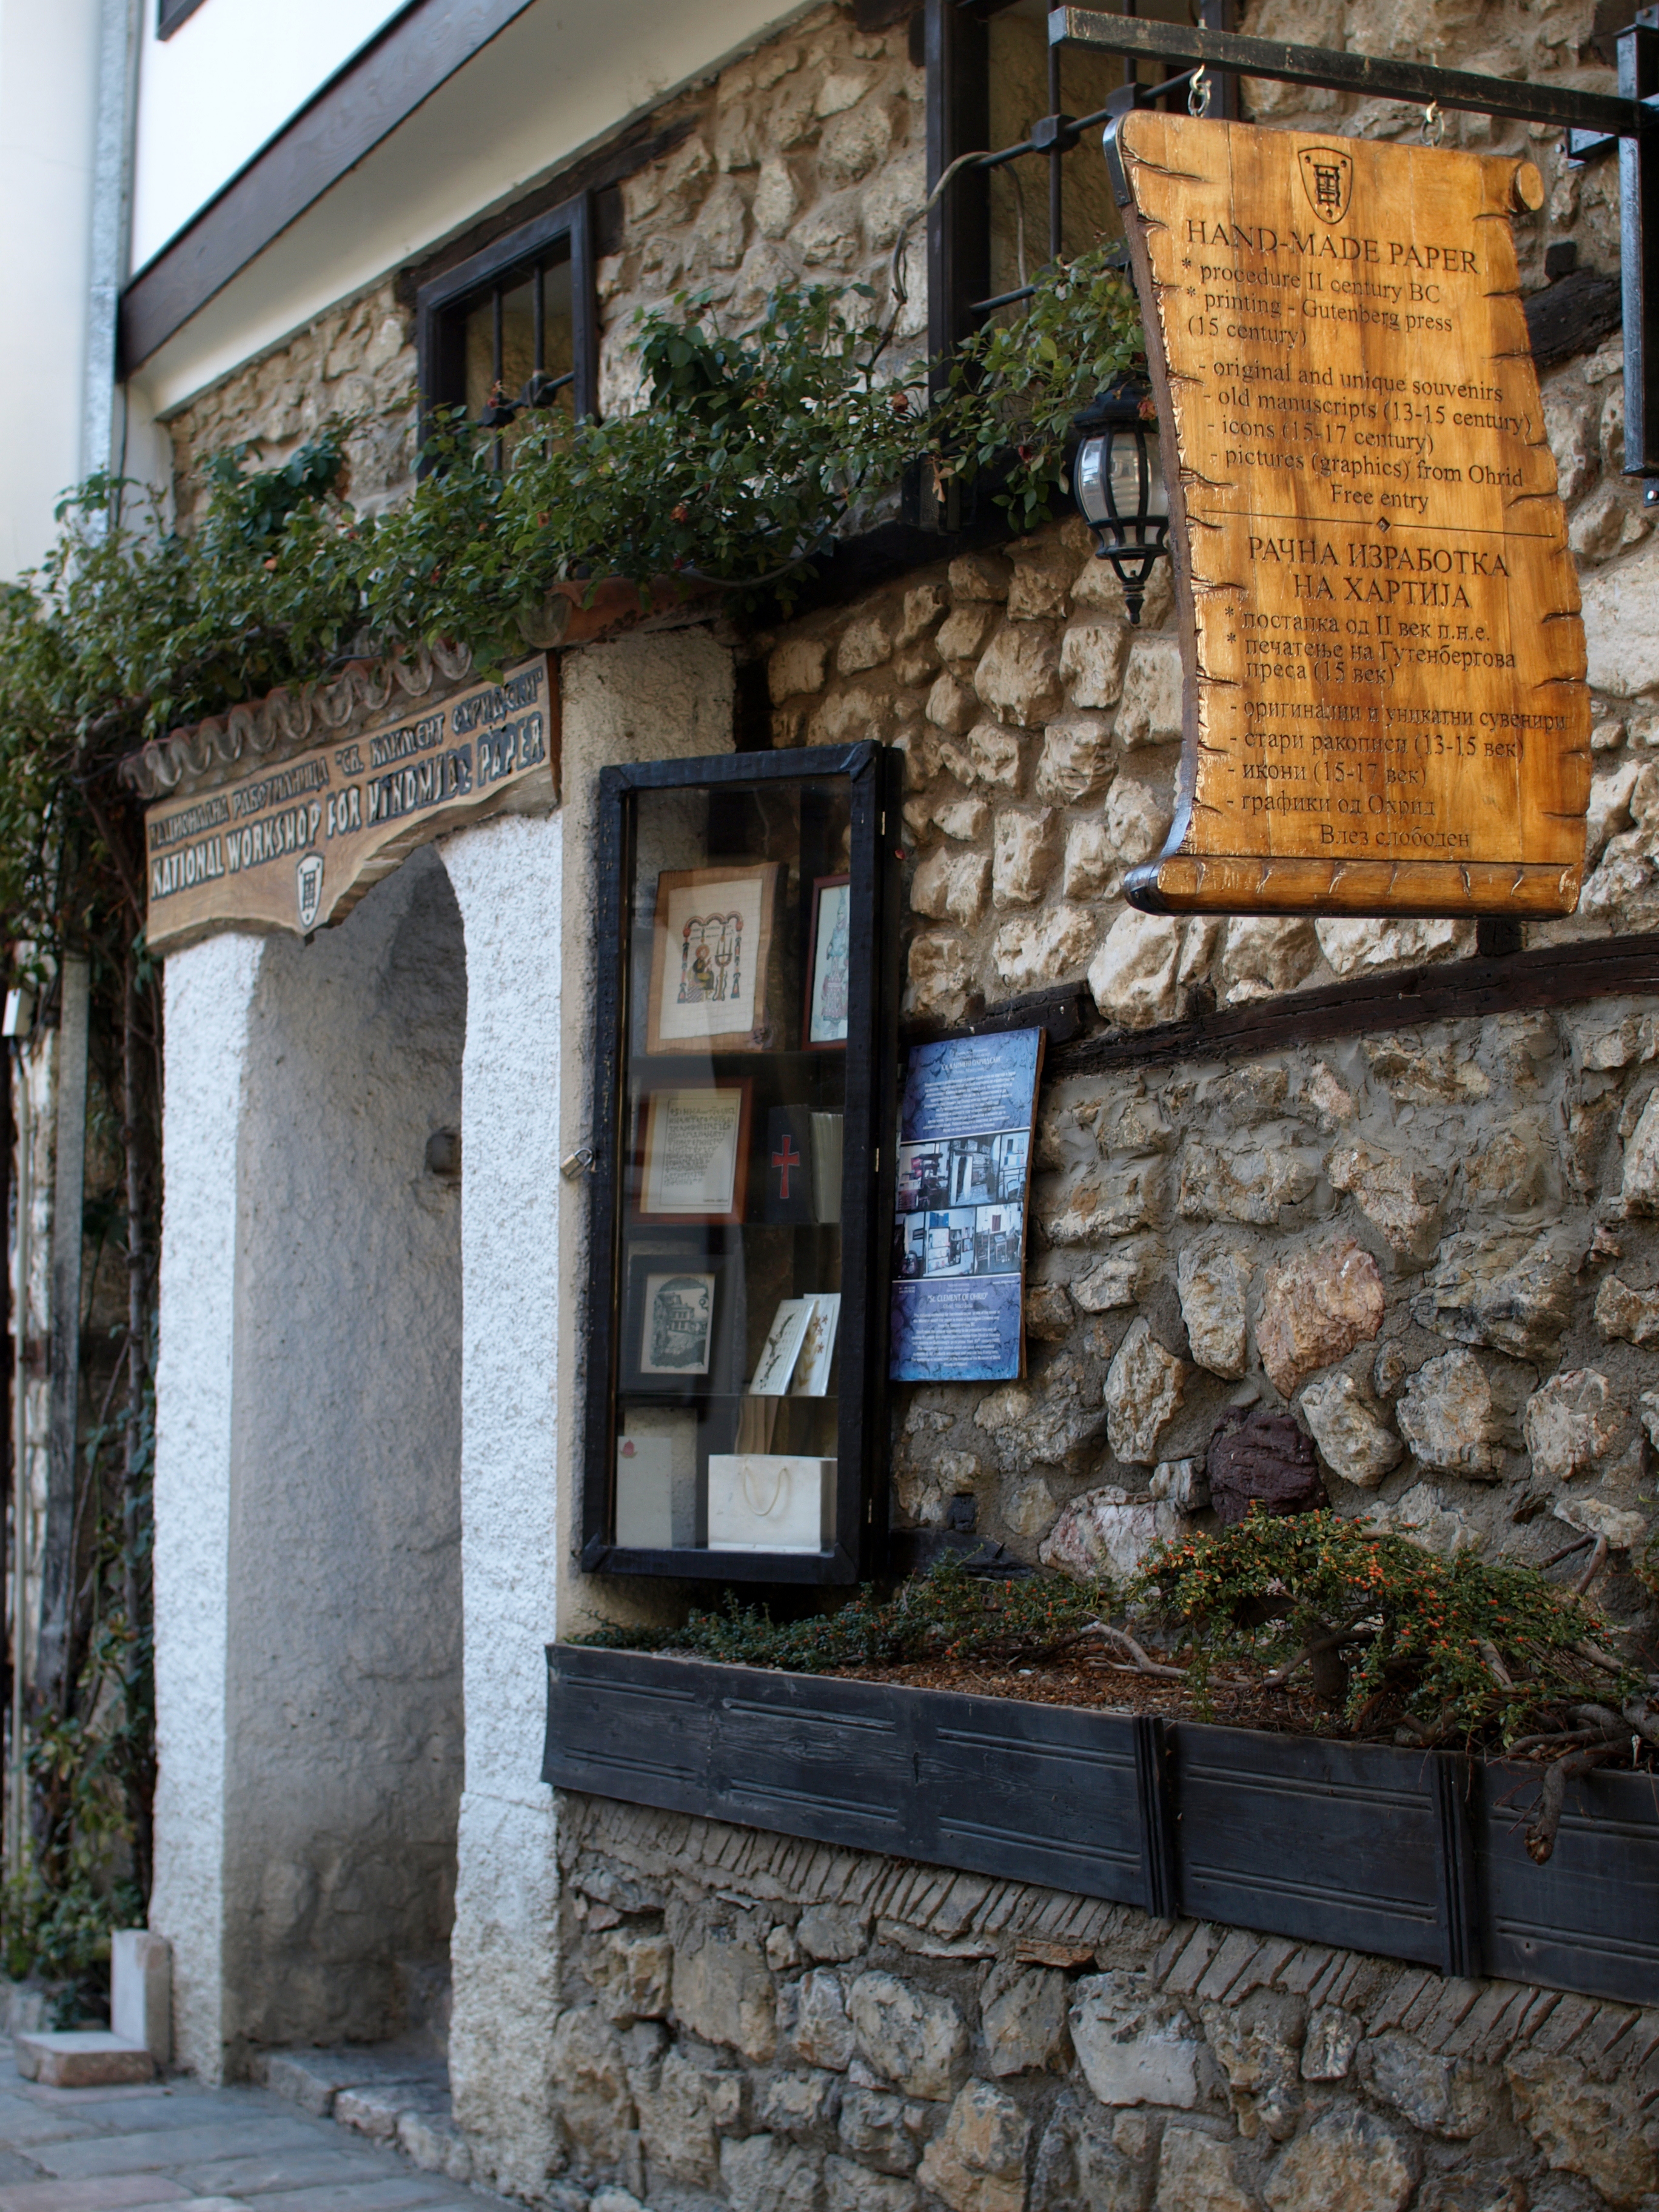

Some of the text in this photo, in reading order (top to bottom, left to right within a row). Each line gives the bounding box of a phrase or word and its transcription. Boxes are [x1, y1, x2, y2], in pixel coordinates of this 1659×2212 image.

[1186, 220, 1480, 274] HAND-MADE PAPER
[1200, 264, 1301, 288] procedure
[1309, 272, 1322, 291] II
[1330, 280, 1402, 304] century
[1409, 283, 1439, 303] BC
[1205, 289, 1282, 319] printing
[1304, 299, 1400, 330] Gutenberg
[1406, 313, 1452, 333] press
[1188, 316, 1307, 350] (15 century)
[1213, 357, 1291, 383] original
[1299, 367, 1333, 386] and
[1341, 371, 1406, 396] unique
[1413, 381, 1503, 402] souvenirs
[1219, 387, 1250, 407] old
[1258, 395, 1378, 423] manuscripts
[1384, 401, 1446, 424] (13-15
[1453, 412, 1532, 437] century)
[1222, 415, 1275, 438] icons
[1282, 421, 1347, 444] (15-17
[1355, 432, 1434, 456] century)
[1225, 444, 1304, 469] pictures
[1312, 452, 1410, 483] (graphics)
[1417, 460, 1462, 482] from
[1469, 464, 1523, 487] Ohrid
[1330, 484, 1429, 514] Free entry
[1248, 537, 1510, 577] РАЧНА ИЗРАБОТКА
[1293, 574, 1472, 608] НА ХАРТИЈА
[1243, 612, 1339, 633] постапка
[1346, 618, 1370, 637] од
[1376, 615, 1392, 635] II
[1398, 621, 1431, 638] век
[1438, 625, 1490, 641] п.н.е.
[1245, 640, 1343, 659] печатење
[1350, 645, 1375, 662] на
[1380, 641, 1517, 672] Гутенбергова
[1245, 660, 1395, 689] преса (15 век)
[1244, 701, 1361, 723] оригинални
[1368, 707, 1379, 722] и
[1386, 706, 1473, 728] уникатни
[1480, 711, 1567, 735] сувенири
[1245, 732, 1304, 754] стари
[1312, 735, 1408, 756] ракописи
[1415, 734, 1476, 758] (13-15
[1484, 737, 1524, 764] век)
[1243, 763, 1306, 780] икони
[1313, 760, 1377, 786] (15-17
[1386, 766, 1427, 788] век)
[151, 834, 225, 901] NATIONAL
[226, 799, 321, 874] WORKSHOP
[326, 783, 363, 840] FOR
[477, 711, 546, 788] PAPER
[1241, 790, 1330, 816] графики
[1338, 799, 1361, 815] од
[1368, 794, 1435, 819] Охрид
[1320, 824, 1470, 848] Влез слободен
